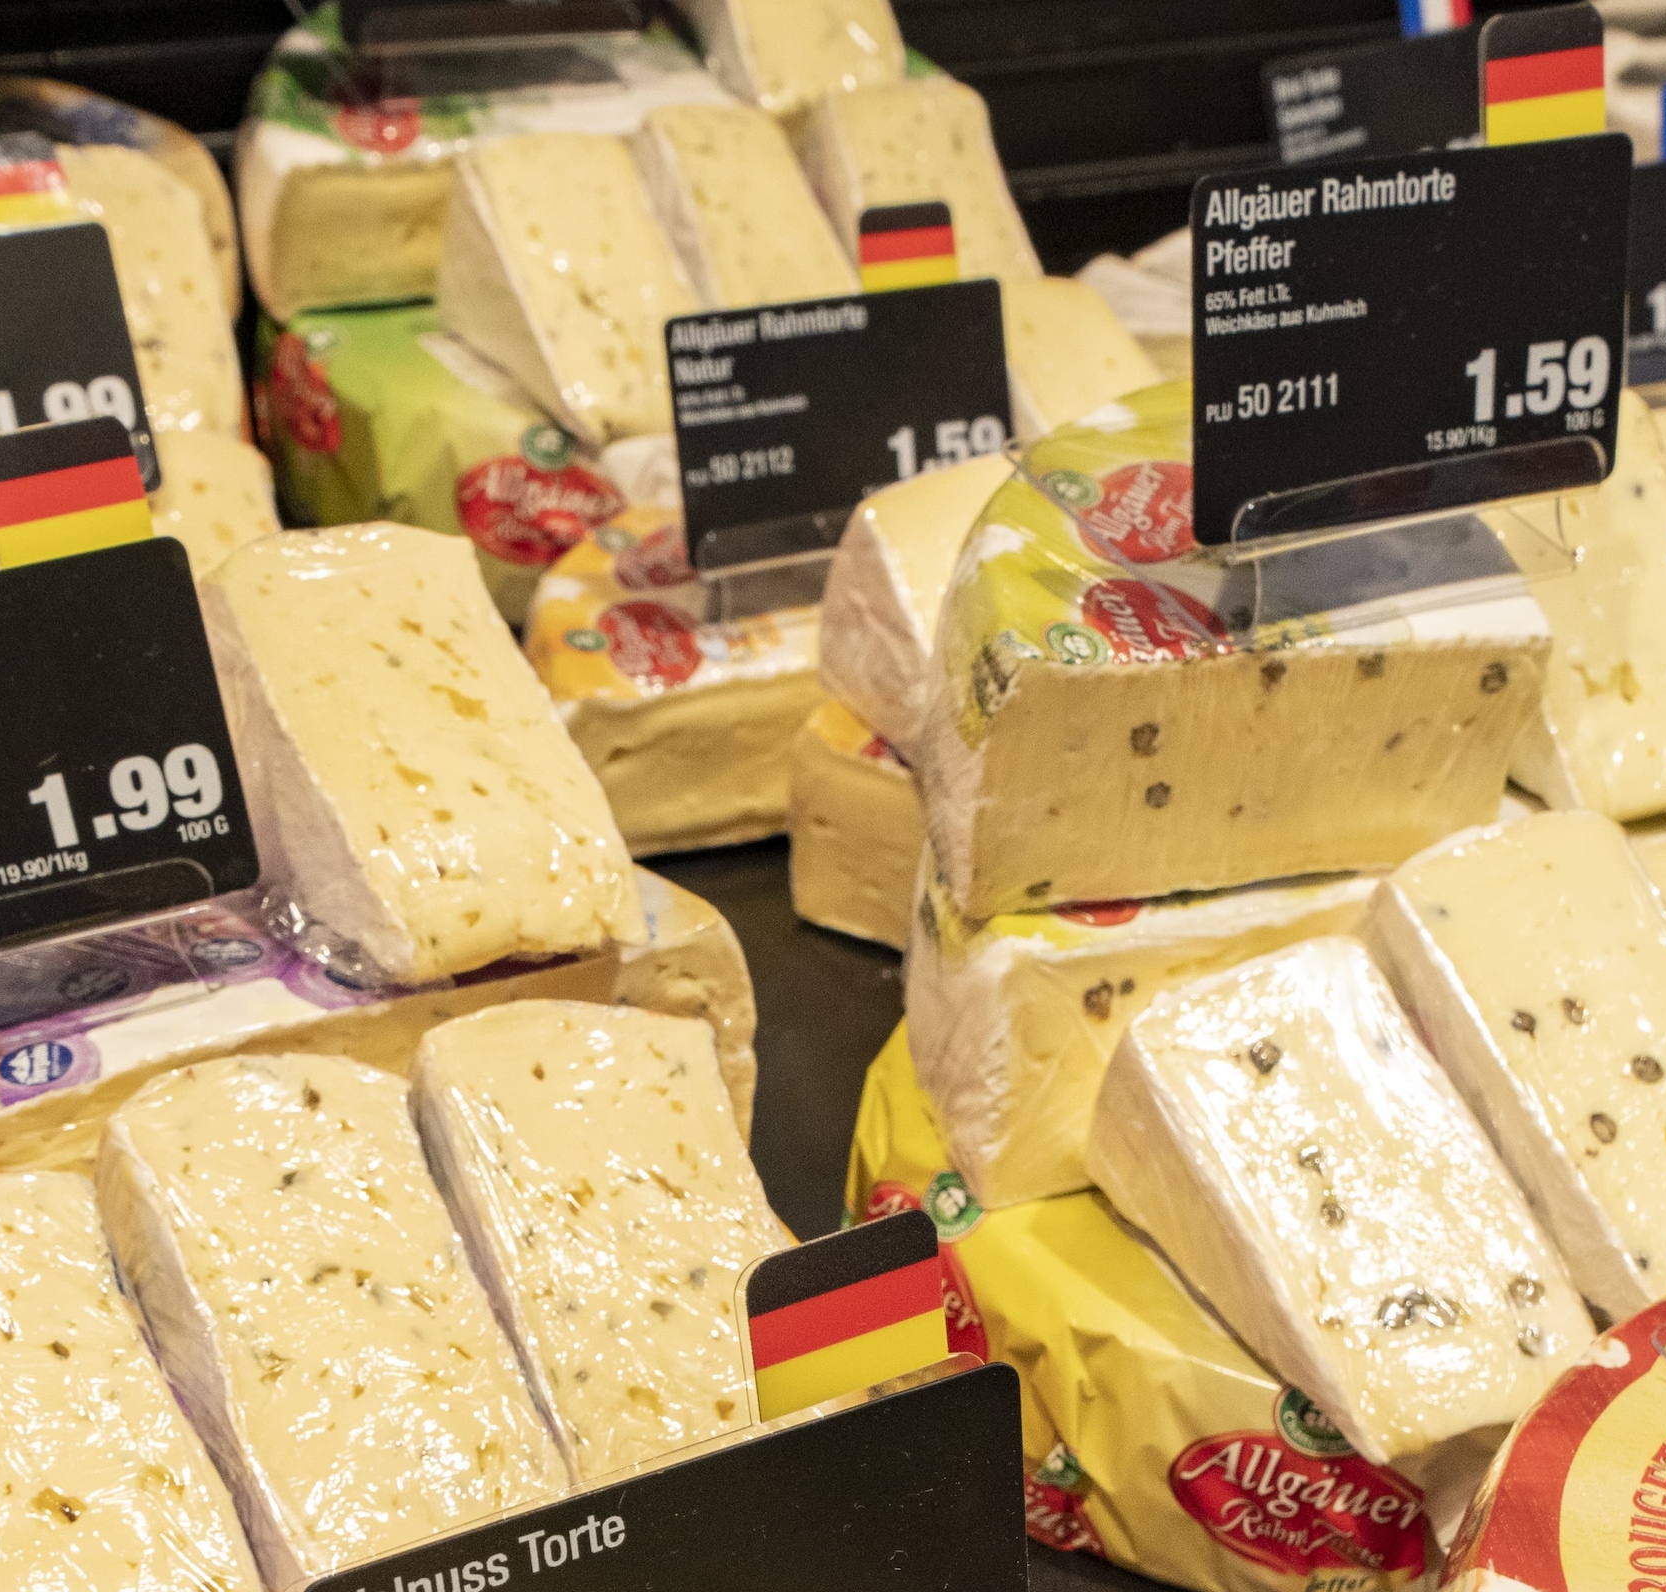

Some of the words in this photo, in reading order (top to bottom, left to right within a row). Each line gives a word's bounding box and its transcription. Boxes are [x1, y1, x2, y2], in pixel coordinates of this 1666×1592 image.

[1205, 184, 1316, 231] Allgäuer
[1321, 168, 1456, 215] Rahmtorte
[1206, 236, 1297, 277] Pfeffer
[1205, 290, 1237, 312] 65%
[1238, 286, 1267, 308] Fett
[1205, 310, 1277, 337] Weichkäse
[1279, 308, 1305, 328] aus
[1306, 299, 1368, 324] Kuhmilch
[1205, 402, 1232, 424] PLU
[1237, 384, 1270, 420] 50
[1276, 372, 1339, 415] 2111
[1466, 336, 1611, 423] 1.59
[28, 743, 224, 850] 1.99
[175, 821, 212, 843] 100
[213, 814, 231, 836] G
[1179, 1440, 1426, 1530] Allgäuer
[518, 1513, 627, 1574] Torte
[1214, 1497, 1309, 1549] Rahm
